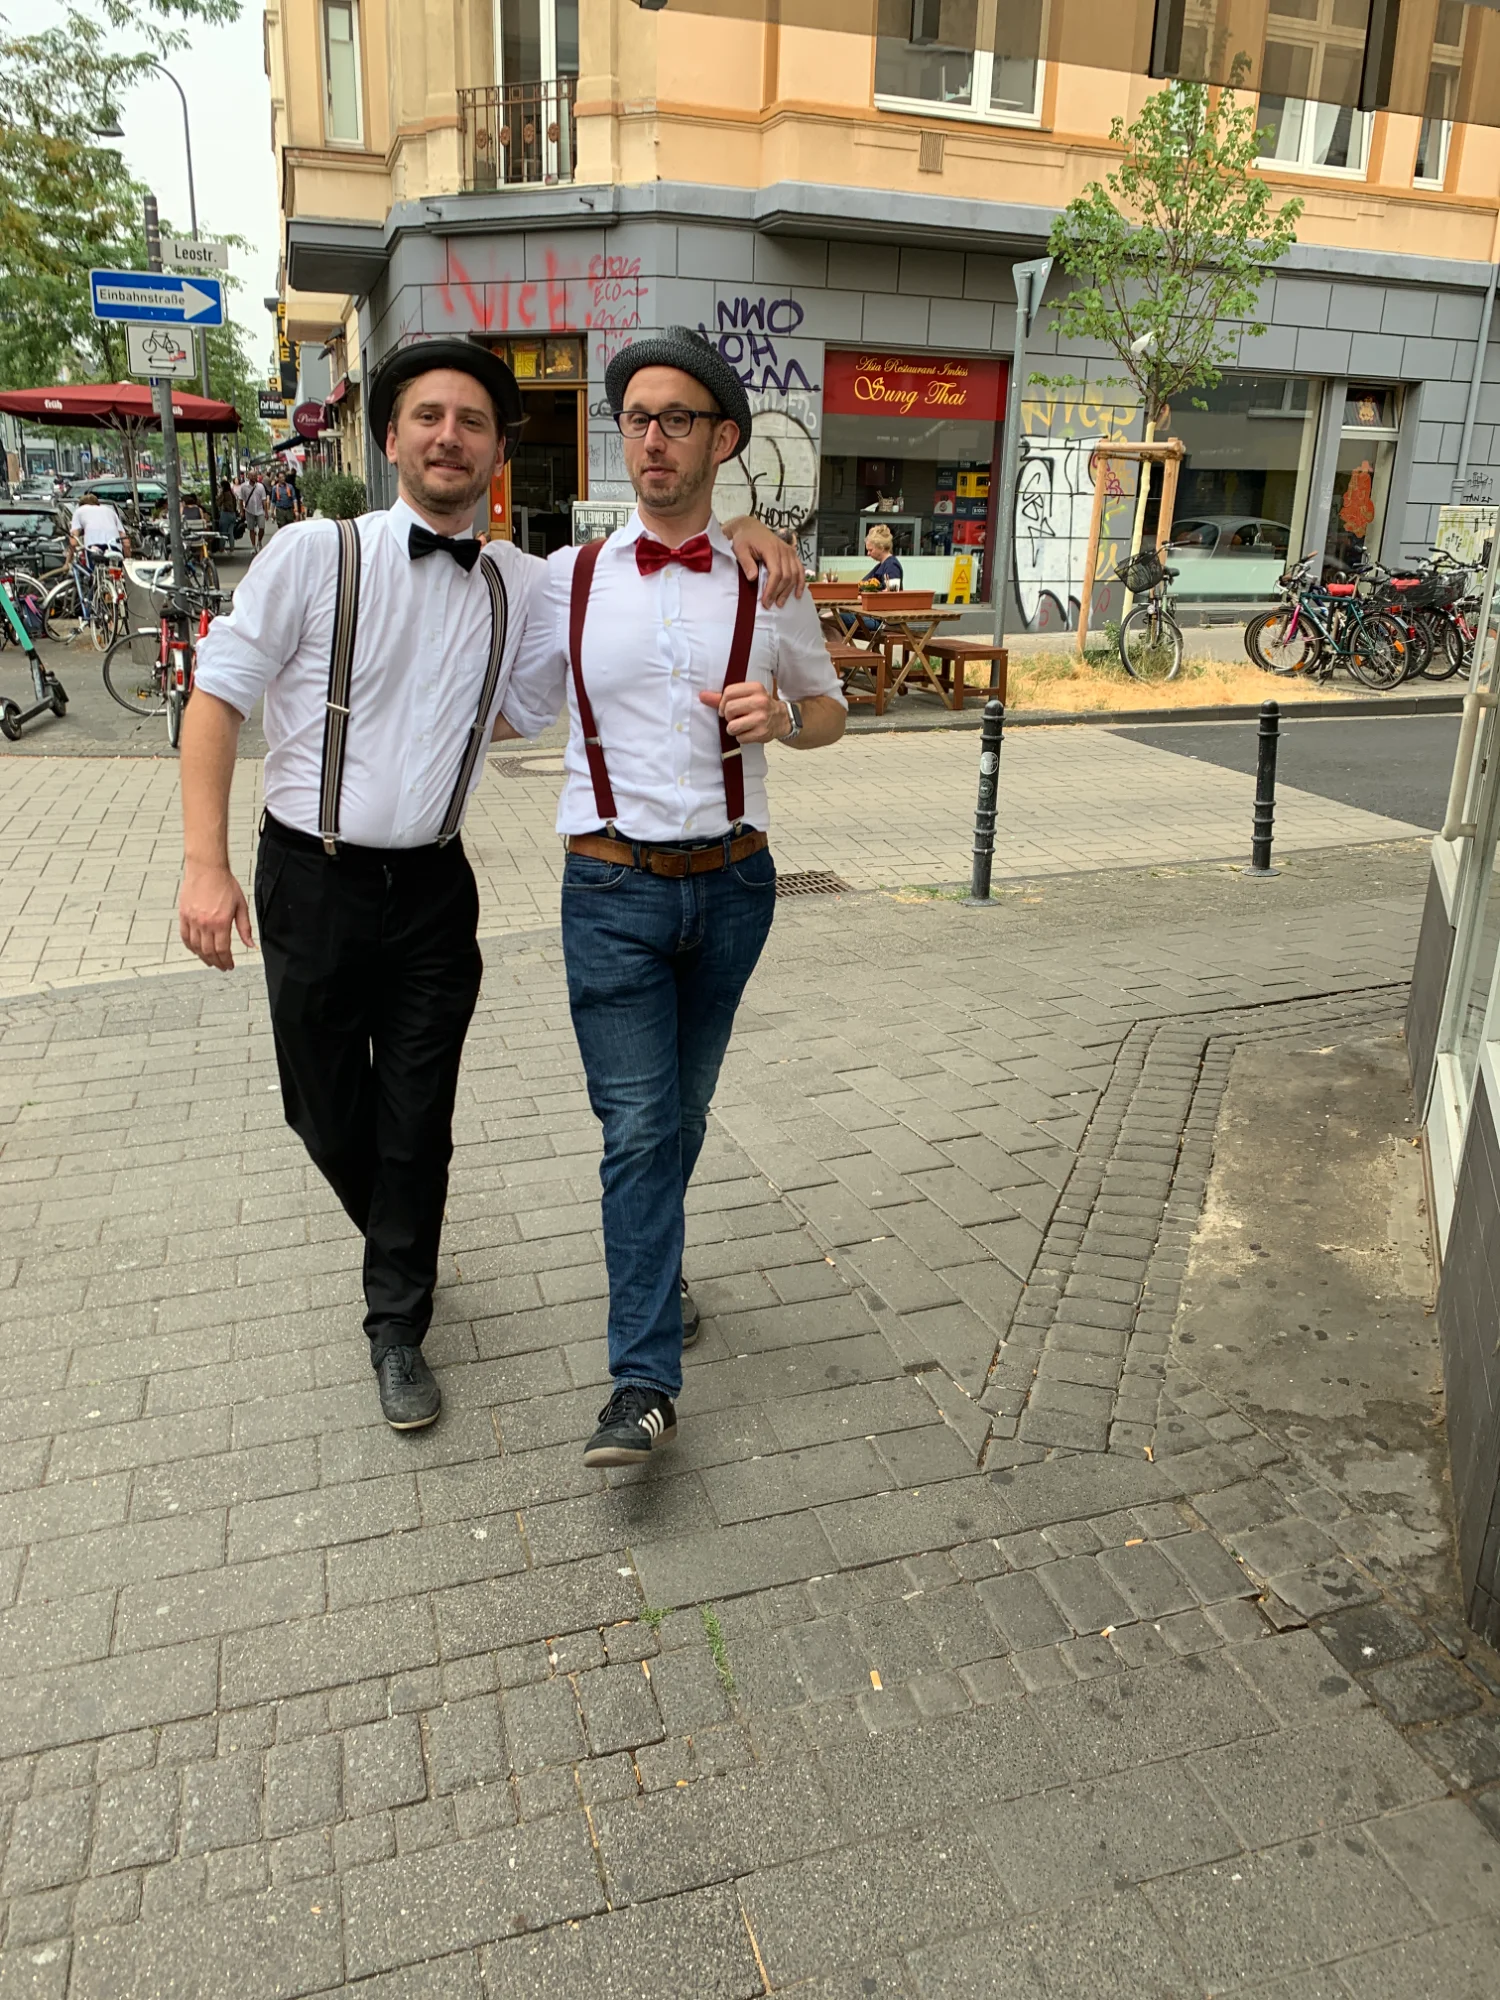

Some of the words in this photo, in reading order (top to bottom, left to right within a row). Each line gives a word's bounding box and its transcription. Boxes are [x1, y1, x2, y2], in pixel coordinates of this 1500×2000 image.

[174, 244, 217, 262] Leostr.
[99, 288, 185, 305] Einbahnstraße
[717, 297, 804, 333] NWO
[856, 356, 882, 371] Asia
[884, 358, 936, 374] Restaurant
[937, 362, 968, 377] Imbiss
[854, 376, 919, 414] Sung
[924, 381, 967, 405] Thai
[44, 399, 63, 411] früh
